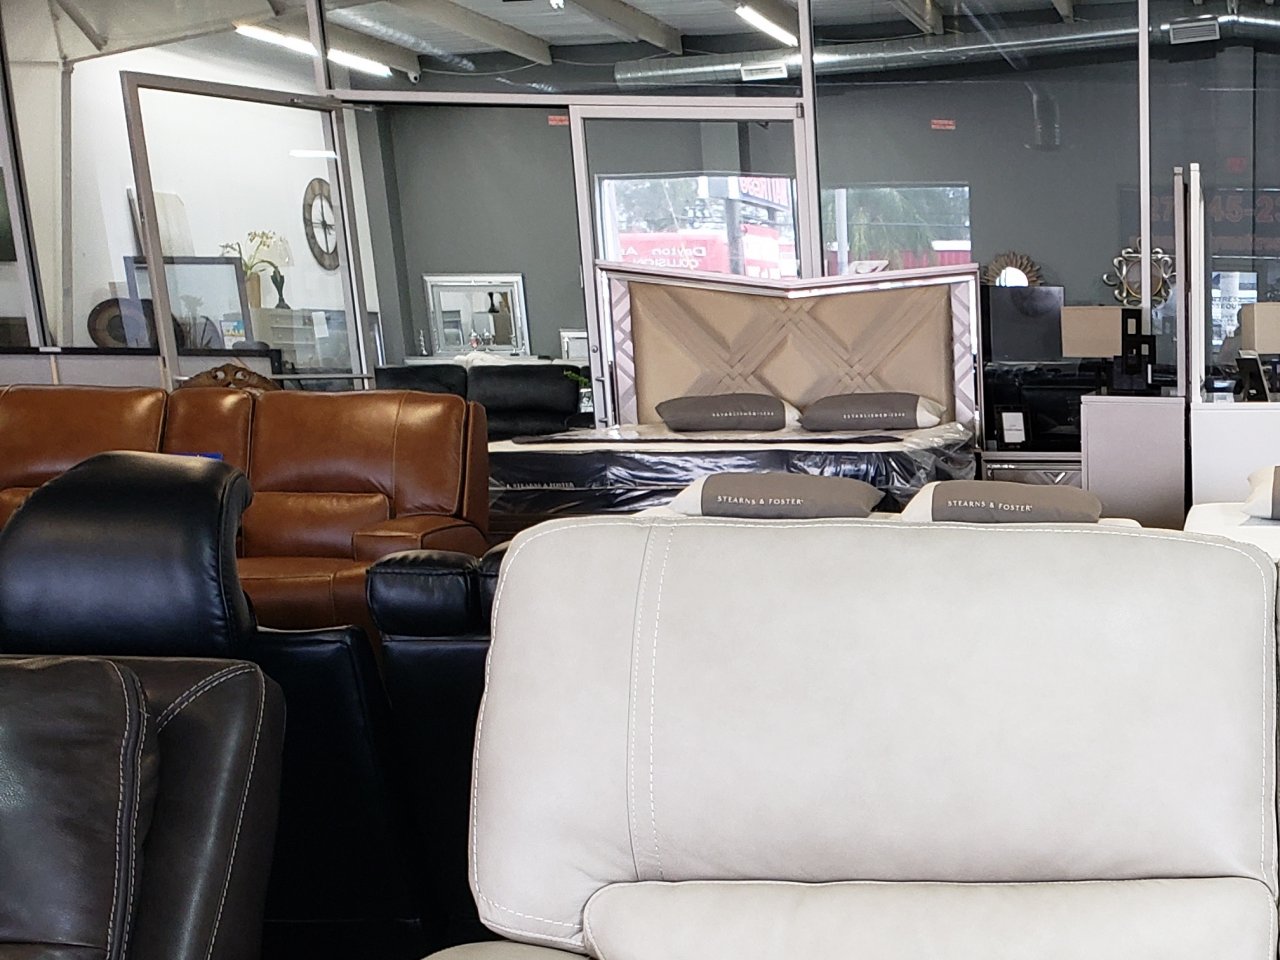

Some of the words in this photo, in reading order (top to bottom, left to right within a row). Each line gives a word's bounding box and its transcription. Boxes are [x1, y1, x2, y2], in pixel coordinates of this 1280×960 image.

[717, 495, 756, 505] STEARNS
[768, 498, 802, 506] FOSTER
[947, 500, 986, 508] STEARNS
[998, 503, 1032, 512] FOSTER
